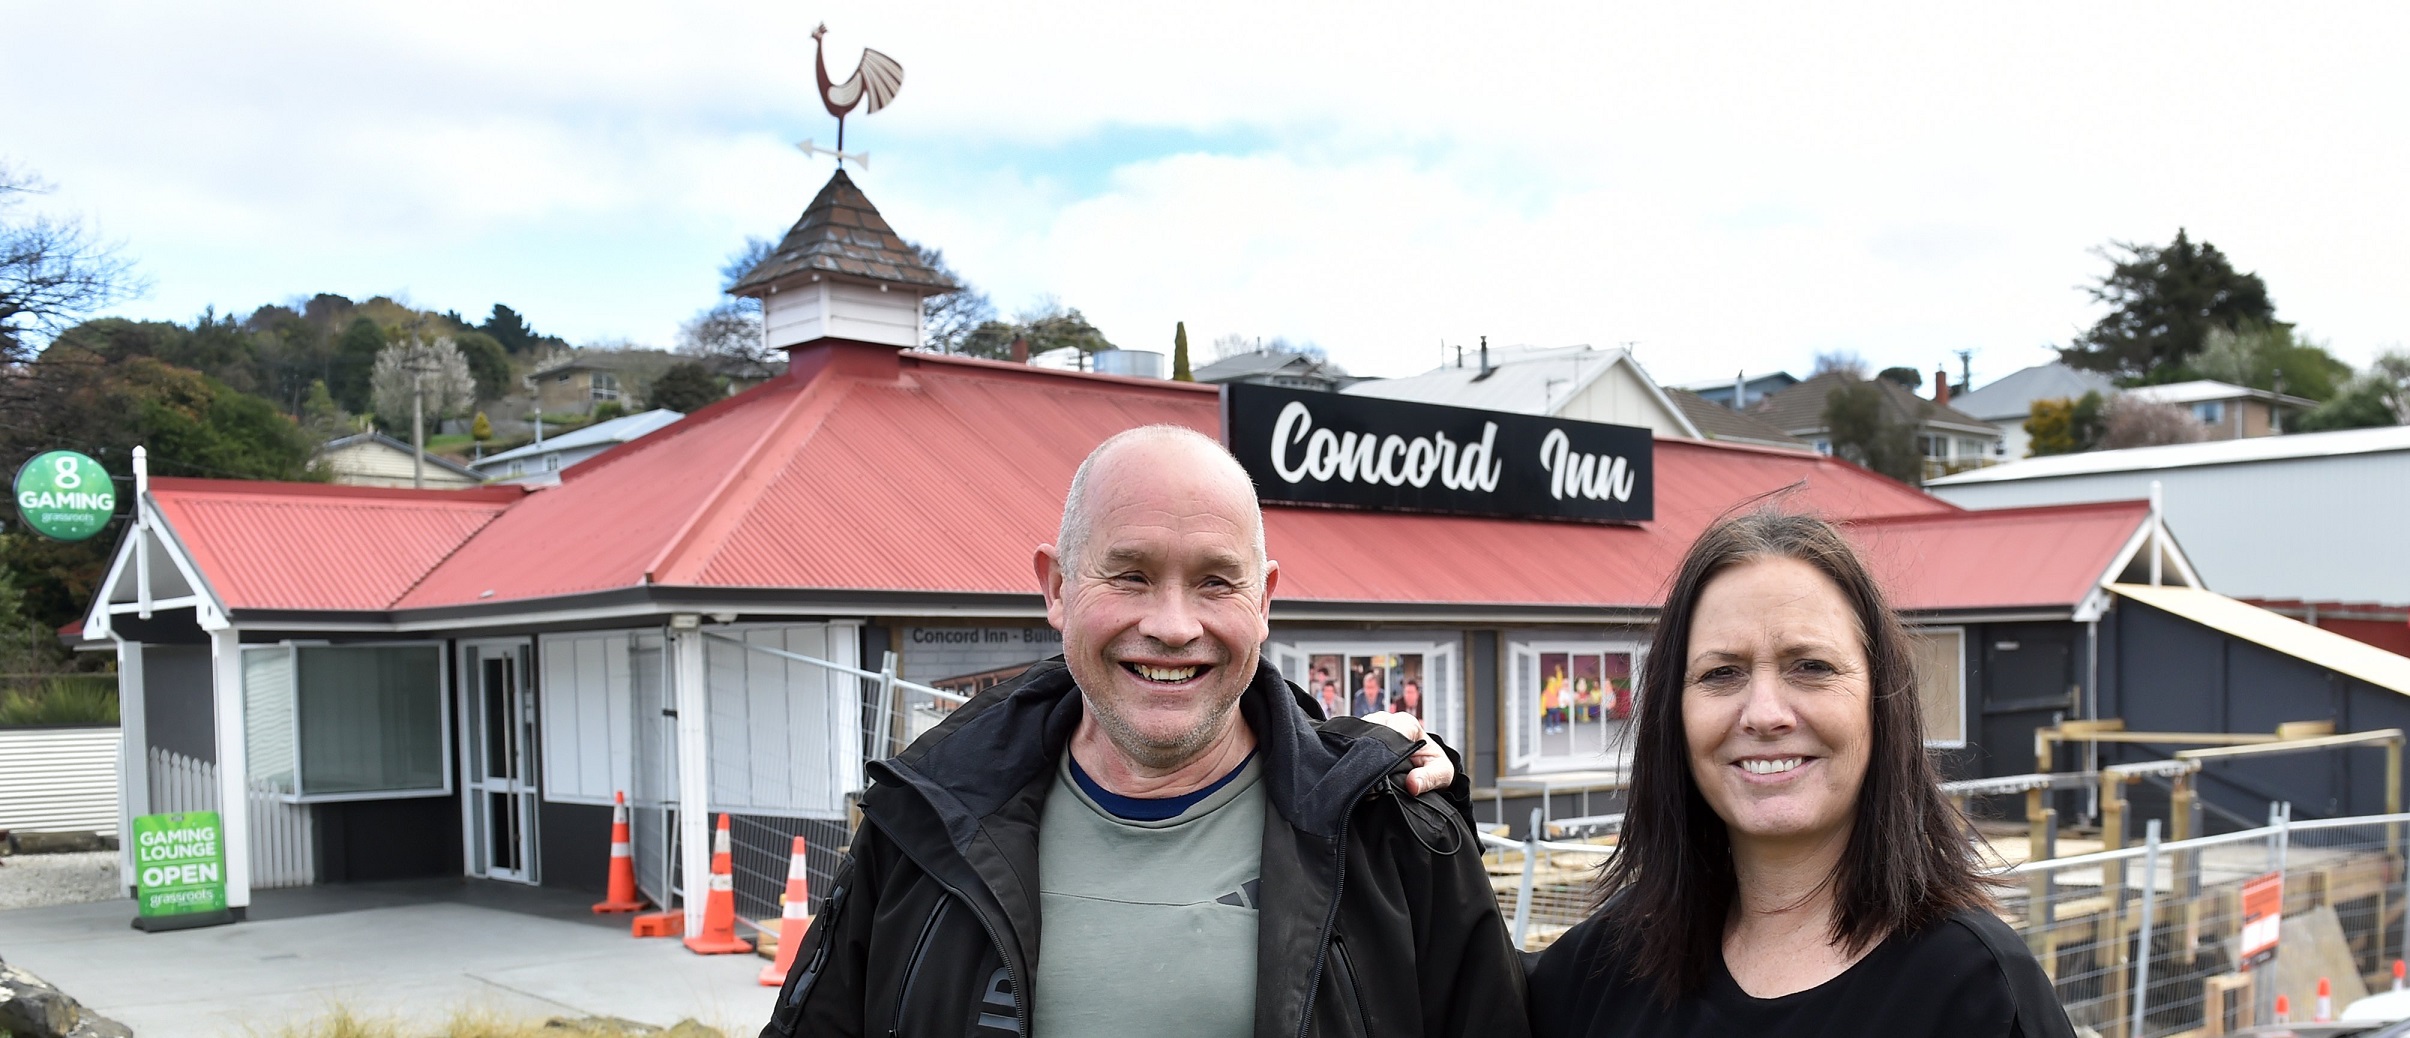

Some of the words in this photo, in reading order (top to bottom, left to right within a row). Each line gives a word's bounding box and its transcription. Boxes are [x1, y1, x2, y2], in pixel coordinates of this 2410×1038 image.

[1270, 401, 1501, 493] Concord
[1540, 428, 1635, 502] Inn
[54, 456, 81, 489] 8
[18, 491, 114, 510] GAMING
[913, 627, 979, 643] Concord
[984, 628, 1008, 643] Inn
[140, 826, 215, 847] GAMING
[140, 842, 216, 862] LOUNGE
[142, 862, 218, 888] OPEN
[150, 889, 214, 909] grassroots
